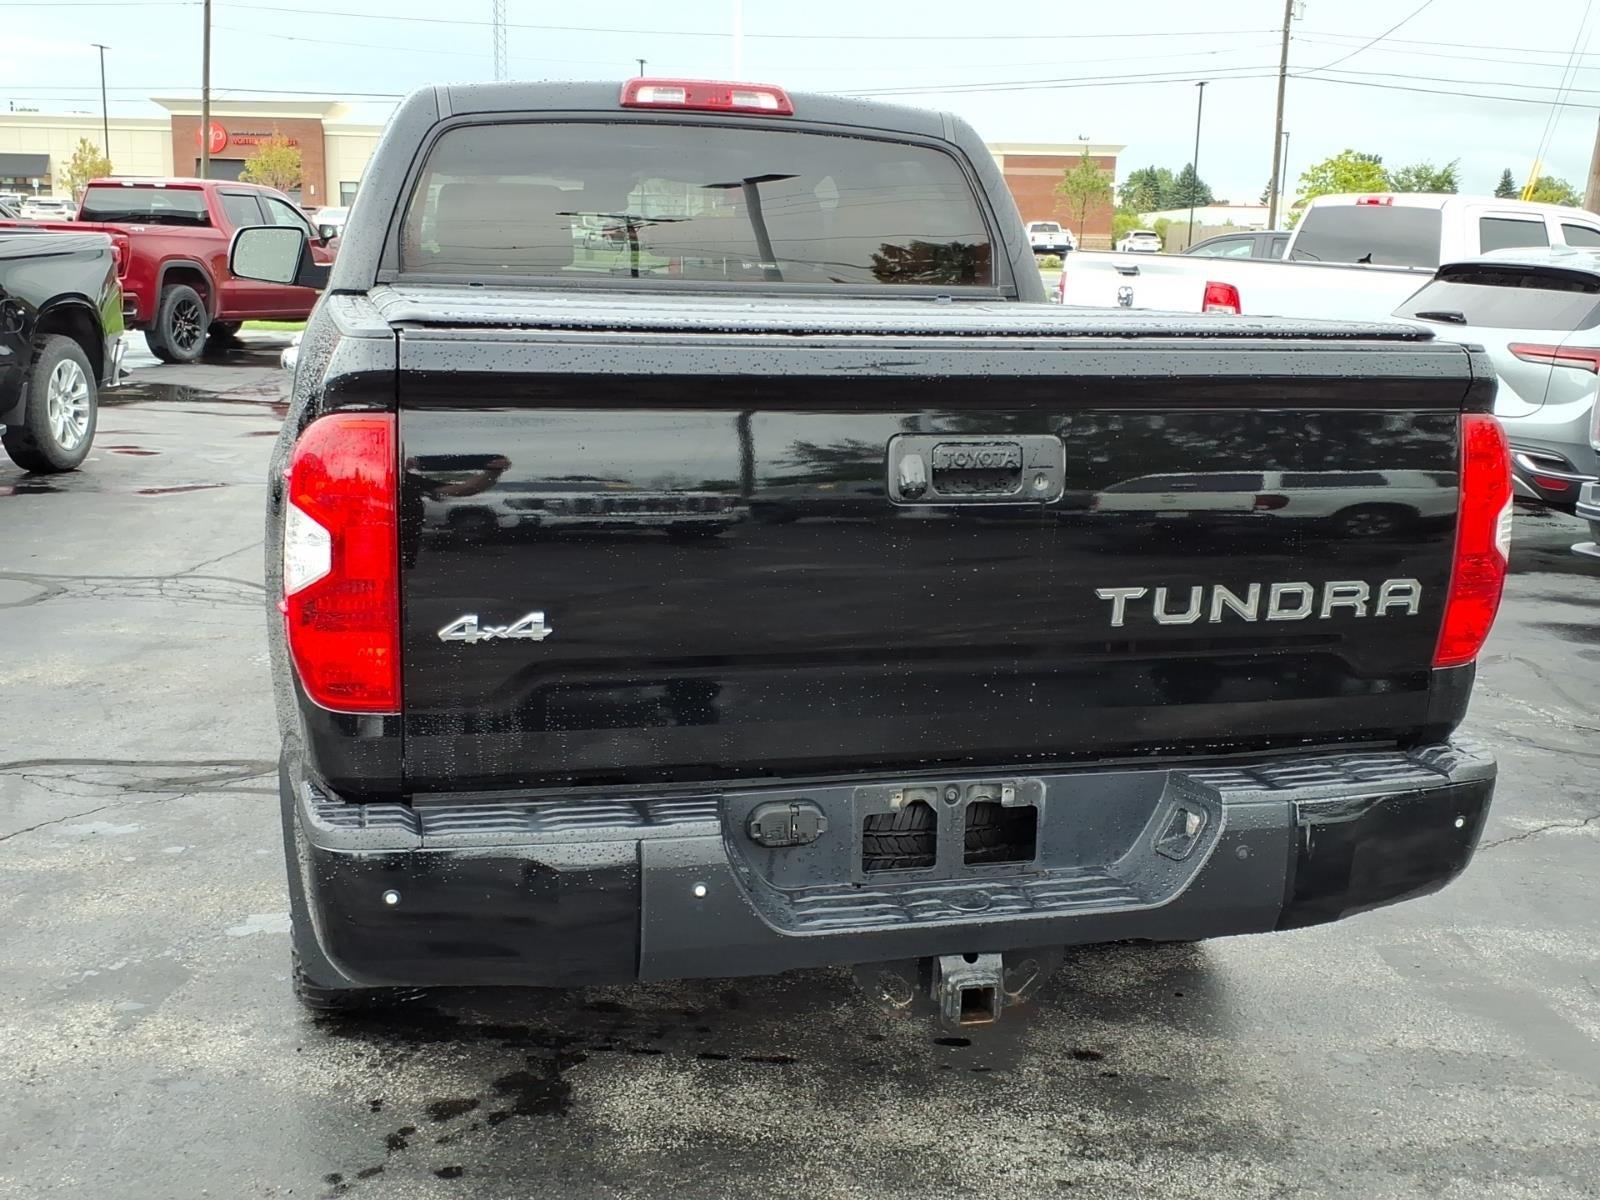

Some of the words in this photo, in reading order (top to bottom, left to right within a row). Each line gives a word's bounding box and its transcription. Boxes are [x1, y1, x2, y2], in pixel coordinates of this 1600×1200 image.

[943, 452, 1018, 468] TOYOTA
[1095, 578, 1423, 627] TUNDRA
[437, 610, 553, 644] 4x4
